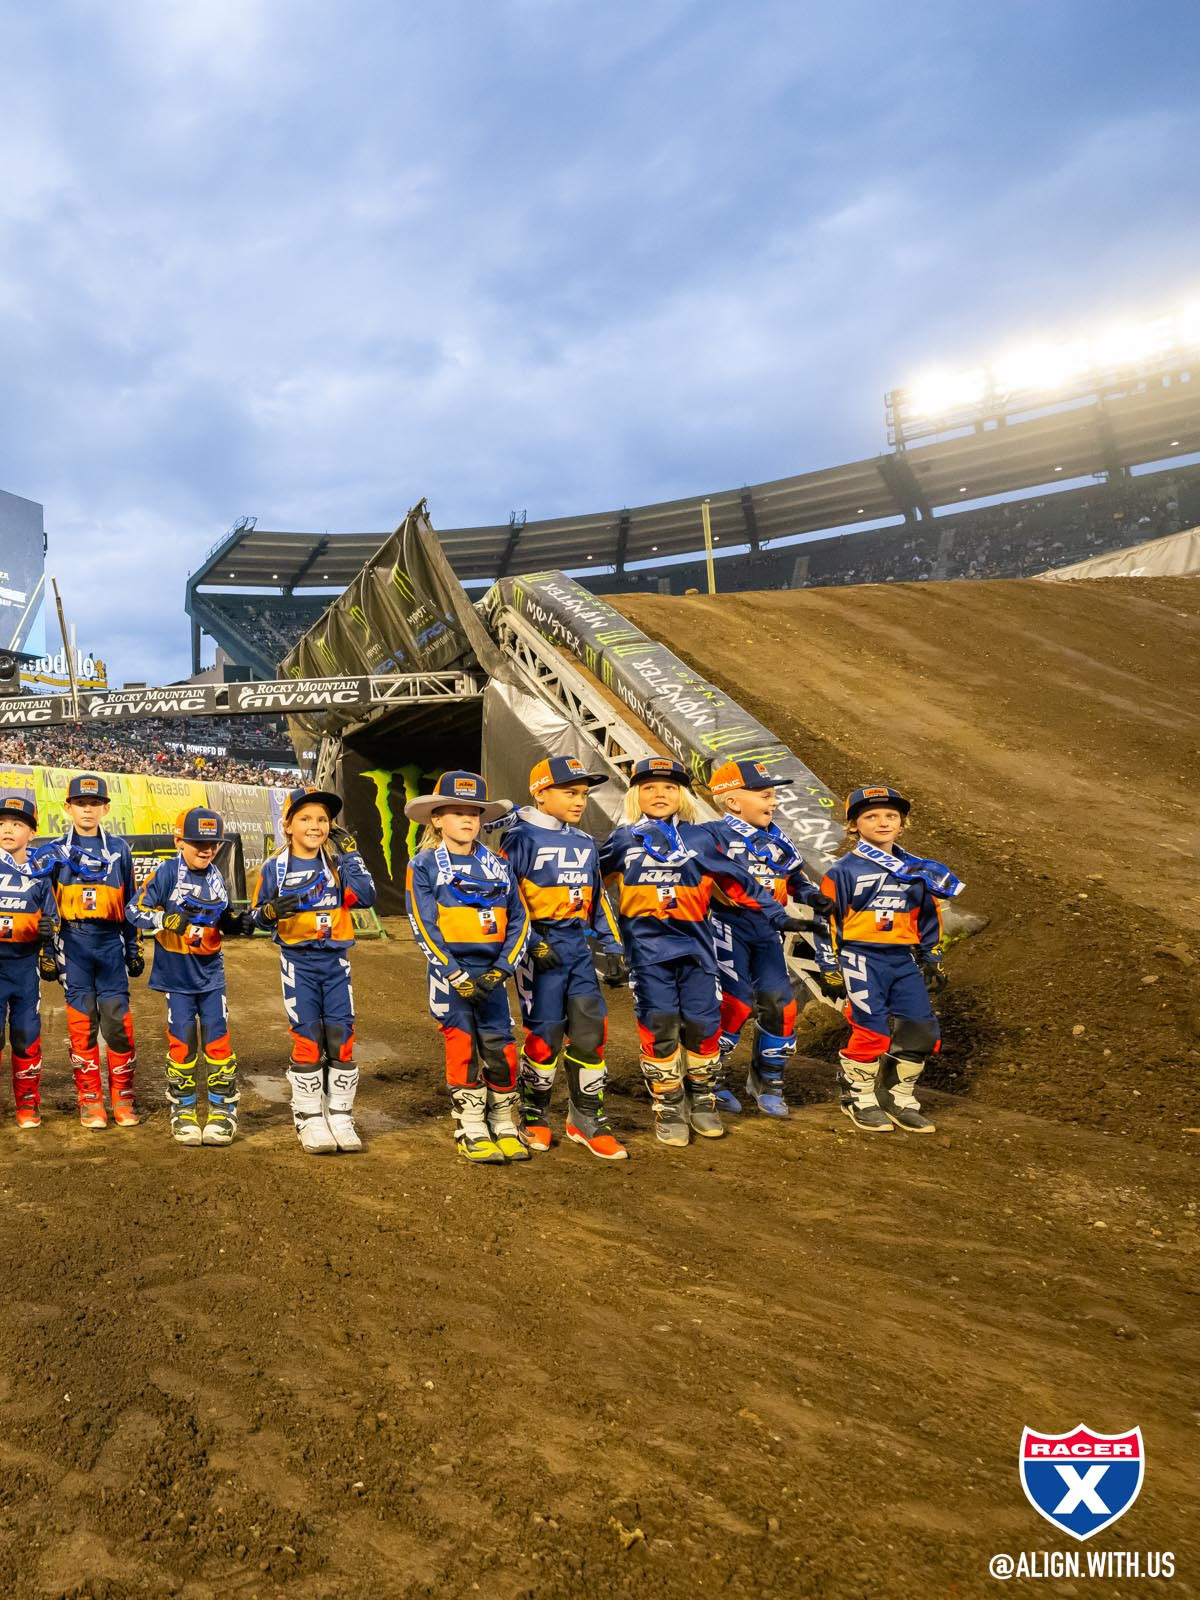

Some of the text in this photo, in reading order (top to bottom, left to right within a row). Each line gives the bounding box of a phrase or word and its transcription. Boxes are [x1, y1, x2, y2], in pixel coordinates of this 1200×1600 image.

[540, 583, 608, 629] MONSTER
[526, 600, 583, 656] MONSTER
[256, 681, 360, 693] ROCKY MOUNTAIN
[632, 657, 716, 727] MONSTER
[106, 689, 205, 703] ROCKY MOUNTAIN
[217, 747, 226, 756] BY
[223, 822, 263, 833] MONSTER
[533, 847, 591, 871] FLY
[557, 871, 588, 884] KTM
[638, 870, 682, 883] KTM
[869, 896, 907, 909] KTM
[841, 950, 872, 1014] FLY
